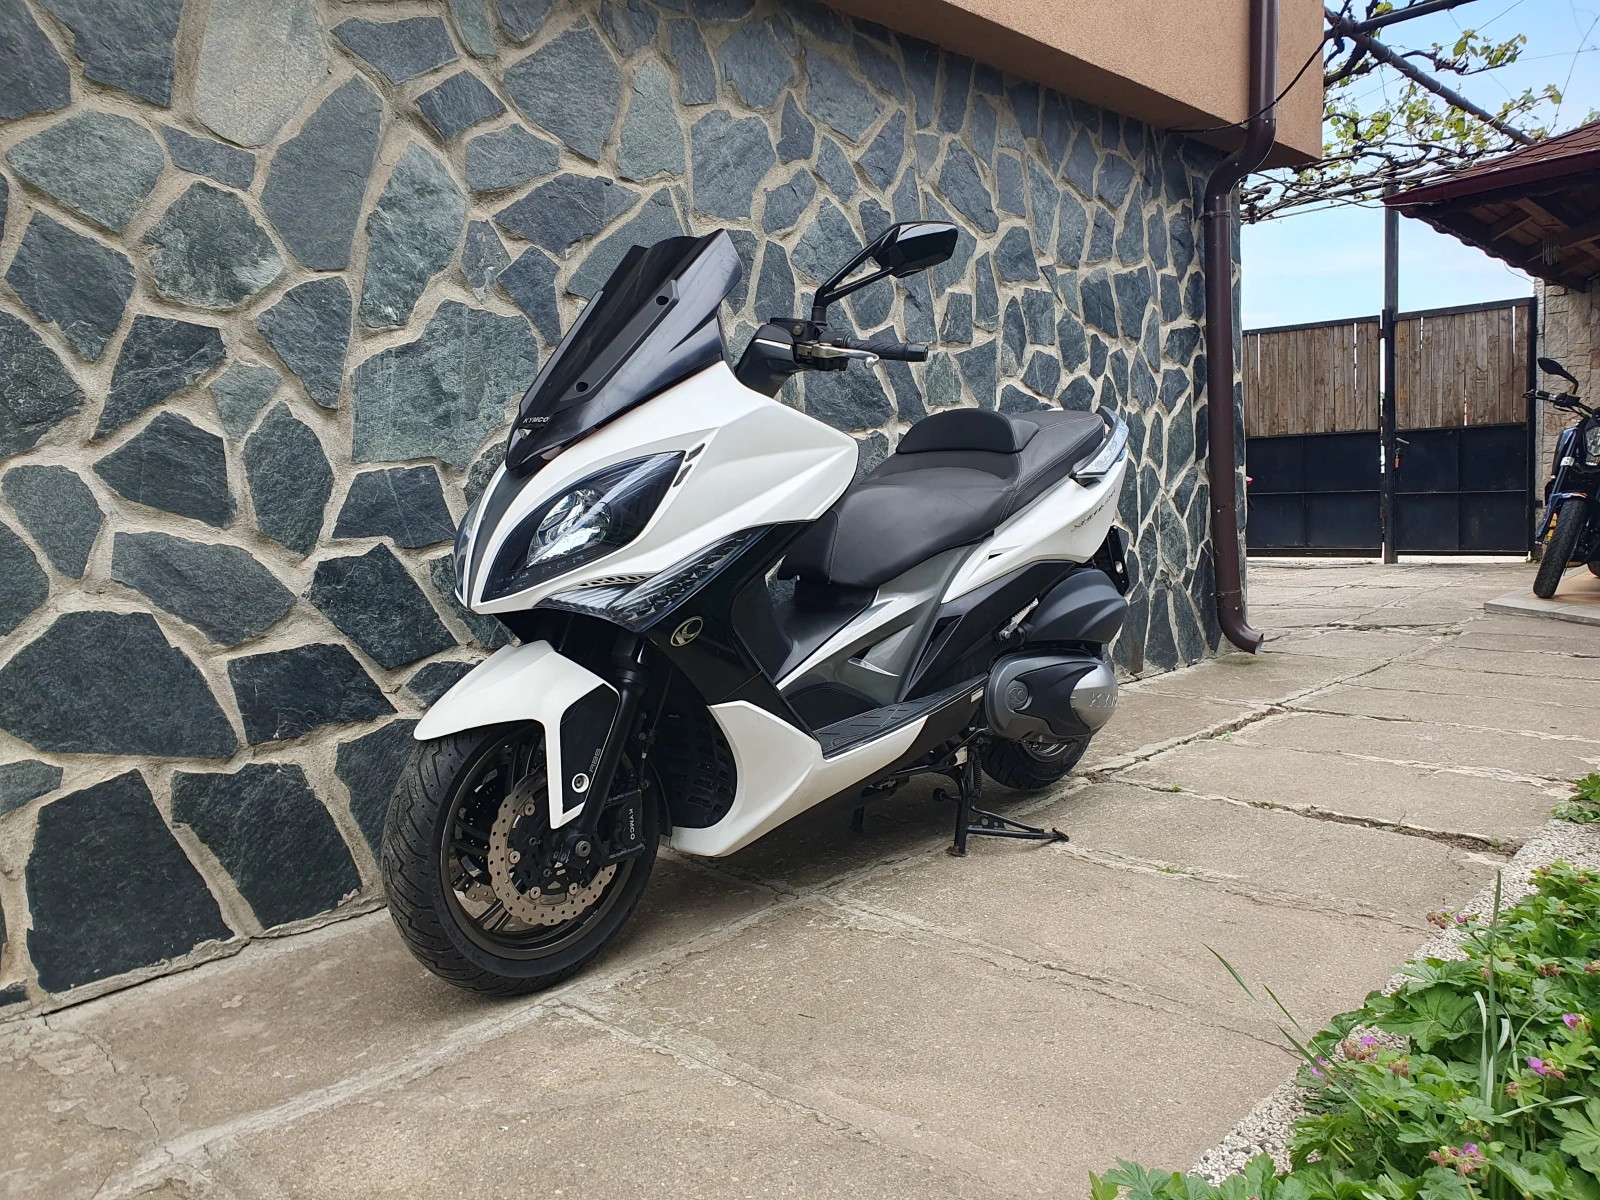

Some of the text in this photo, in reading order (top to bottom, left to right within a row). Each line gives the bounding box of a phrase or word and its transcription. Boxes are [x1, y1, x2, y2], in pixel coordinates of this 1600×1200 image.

[522, 416, 549, 424] KYMCO
[588, 747, 602, 773] ABS
[628, 807, 636, 840] KYMCO
